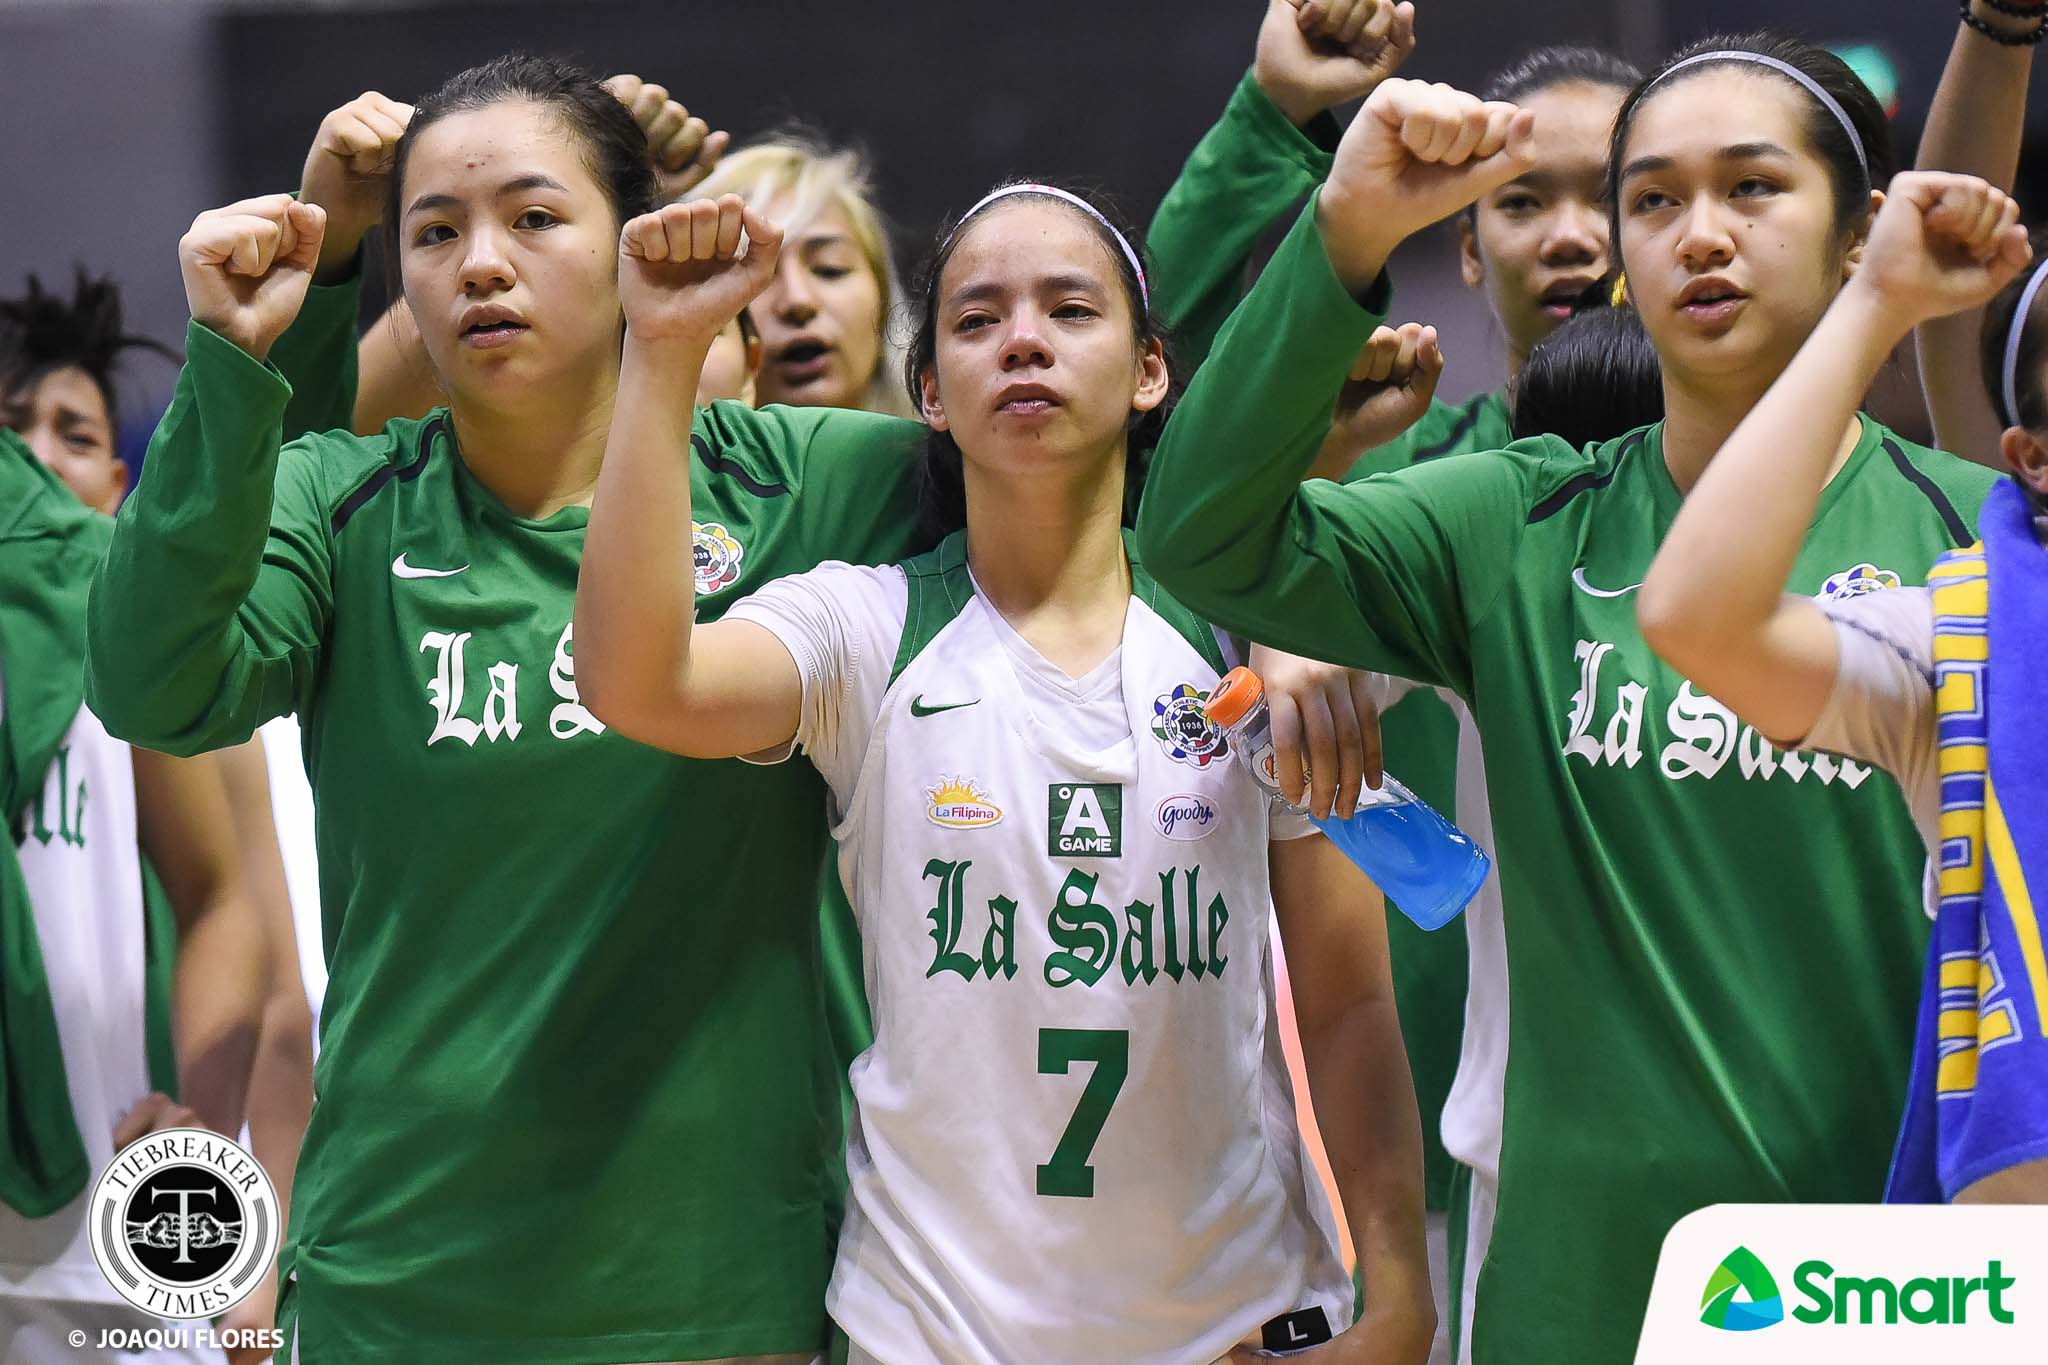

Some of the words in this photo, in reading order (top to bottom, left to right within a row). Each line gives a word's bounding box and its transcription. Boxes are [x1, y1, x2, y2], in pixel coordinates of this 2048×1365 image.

[693, 551, 709, 560] 938
[419, 631, 523, 747] La
[1563, 639, 1649, 769] La
[13, 745, 87, 848] lle
[935, 806, 950, 817] La
[951, 806, 994, 820] Filipina
[1162, 799, 1211, 836] goody
[1059, 837, 1112, 853] GAME
[922, 858, 1019, 982] La
[1044, 864, 1230, 988] Salle
[1036, 1027, 1129, 1198] 7
[1287, 1320, 1308, 1342] L
